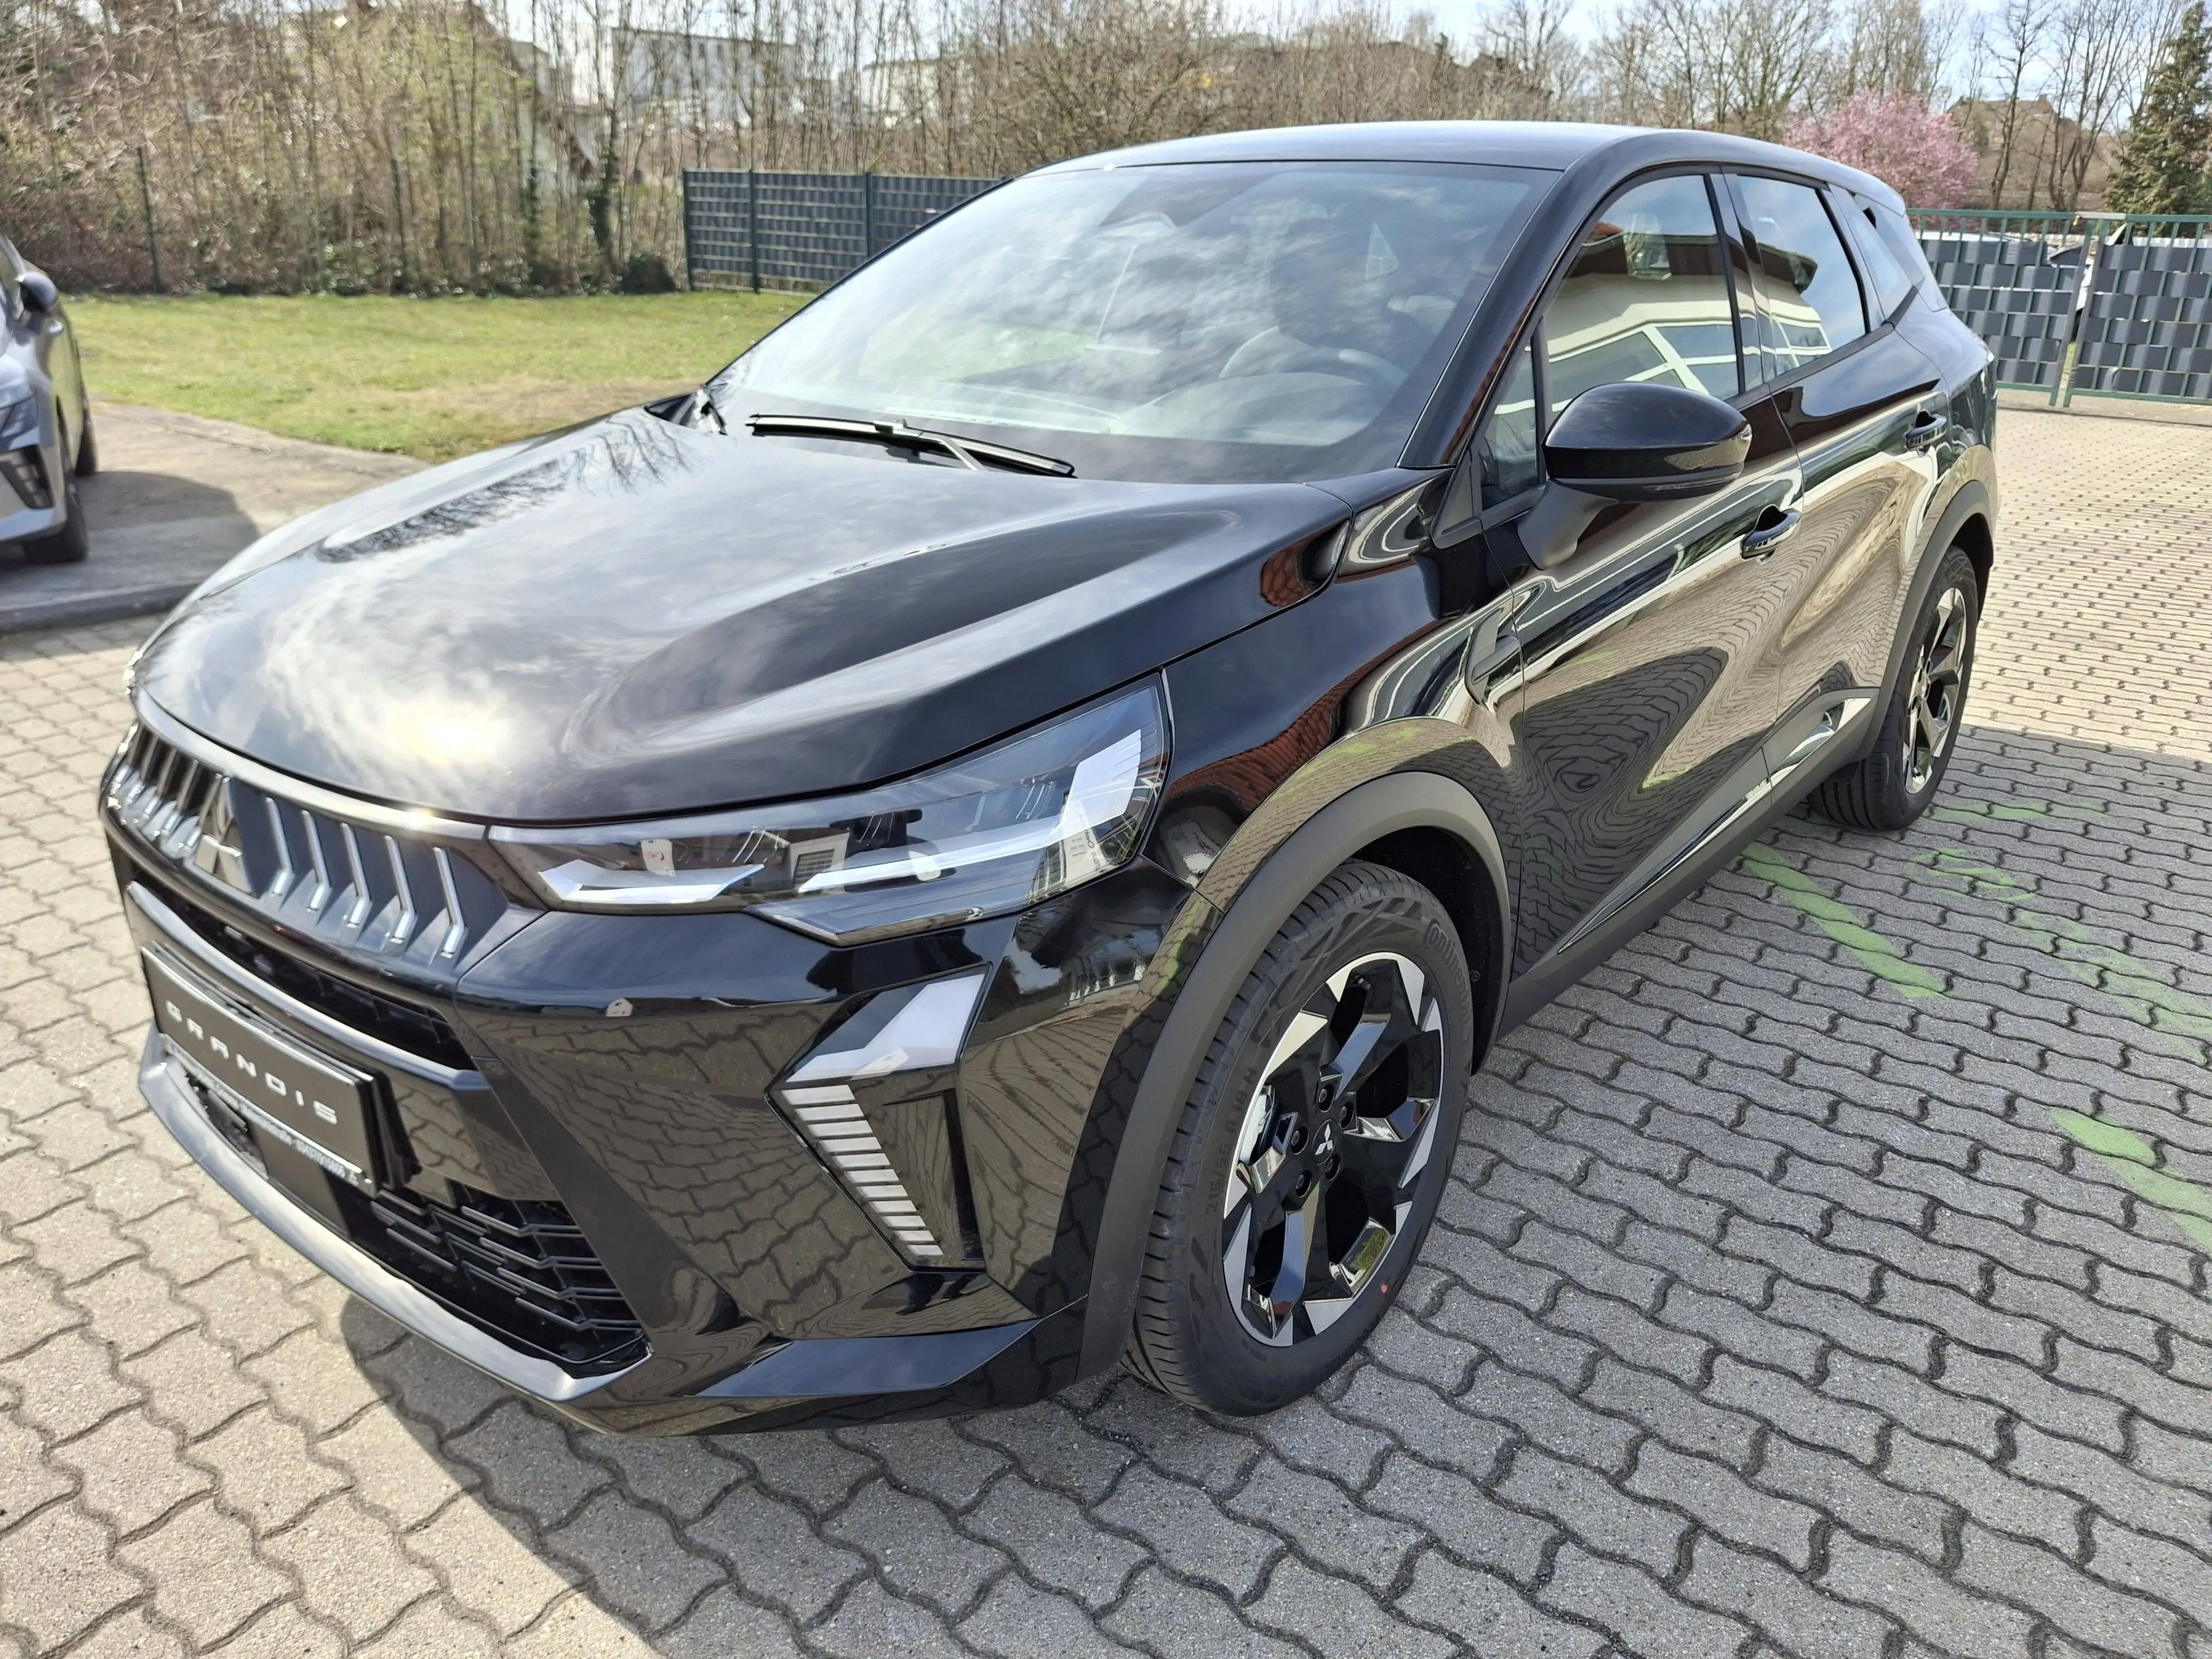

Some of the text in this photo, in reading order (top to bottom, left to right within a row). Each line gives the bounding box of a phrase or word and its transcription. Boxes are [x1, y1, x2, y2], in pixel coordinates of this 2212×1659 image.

[165, 1000, 338, 1125] GRANDIS
[1206, 1141, 1230, 1215] 215/55
[1225, 1121, 1238, 1134] R
[1232, 1090, 1247, 1113] 18
